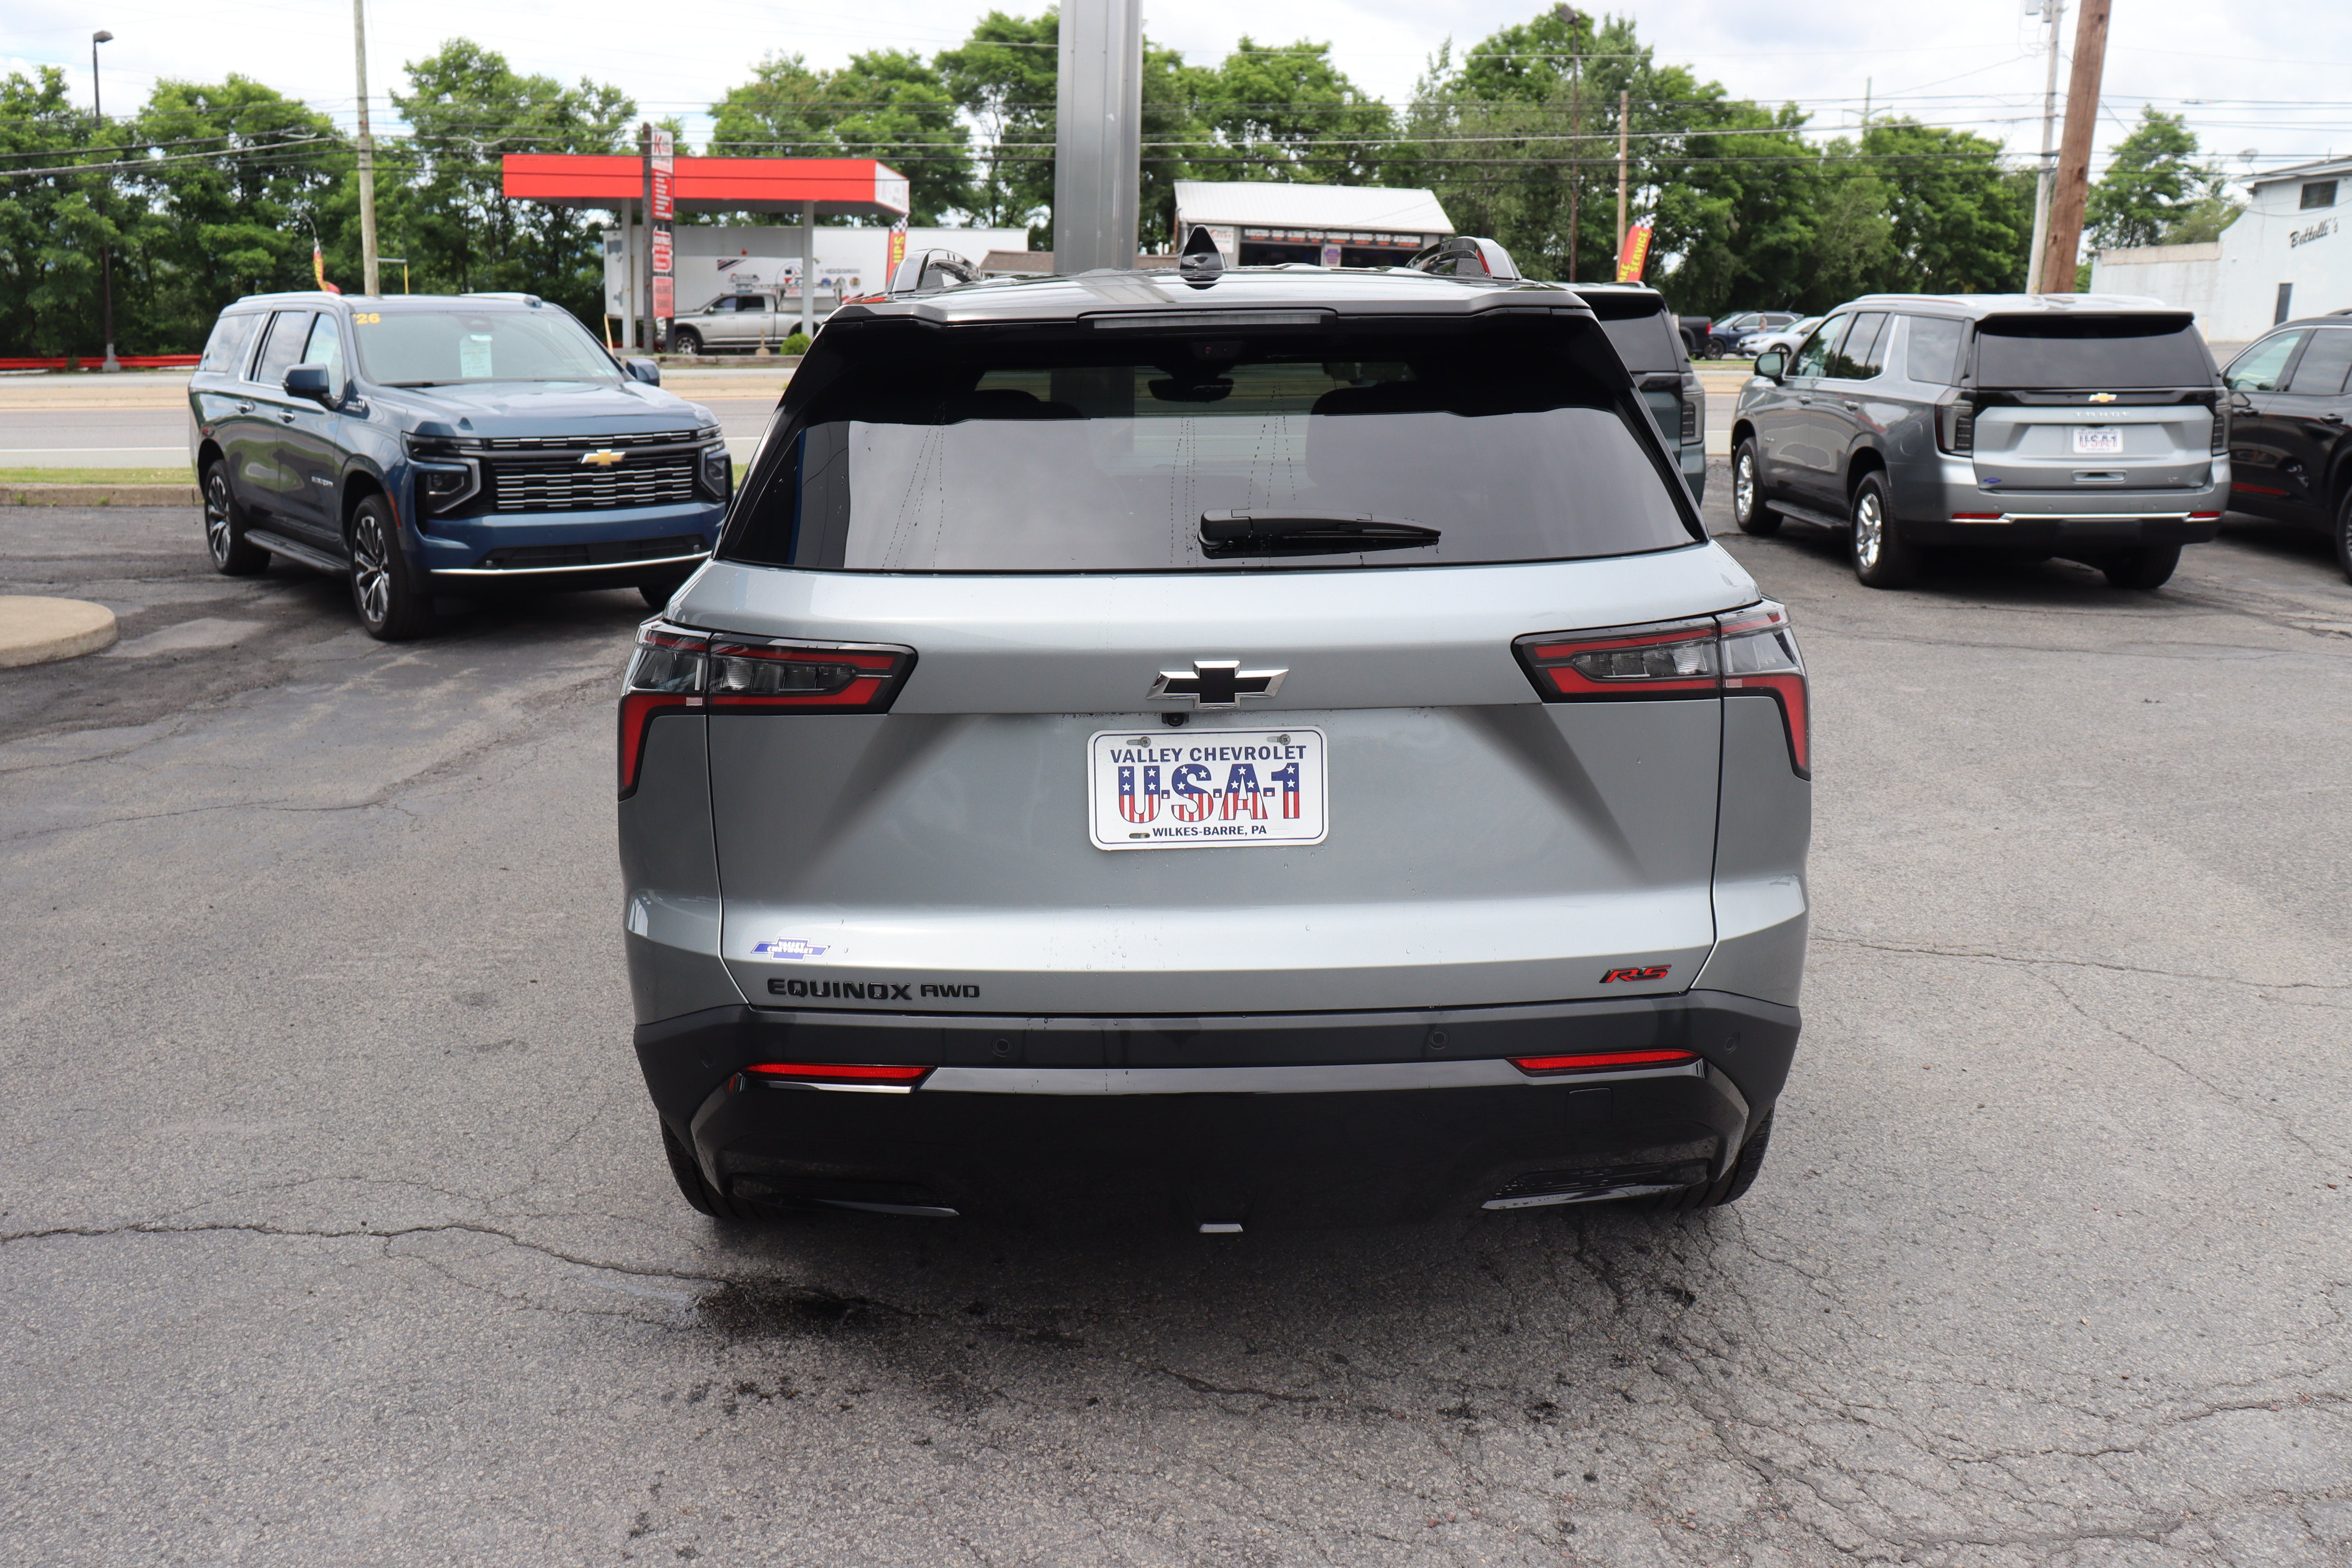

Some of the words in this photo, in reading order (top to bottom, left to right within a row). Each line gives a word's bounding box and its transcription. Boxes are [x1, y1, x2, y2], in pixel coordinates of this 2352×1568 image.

[1630, 230, 1649, 273] SERVICE
[1617, 263, 1630, 281] AKE
[1110, 748, 1182, 763] VALLEY
[1189, 745, 1306, 762] CHEVROLET
[1153, 826, 1247, 837] WILKES-BARRE,
[1252, 825, 1267, 835] PA
[767, 946, 814, 954] CHEVROLET
[1599, 964, 1672, 983] RS
[767, 978, 913, 1000] EQUINOX
[920, 983, 980, 998] AWD
